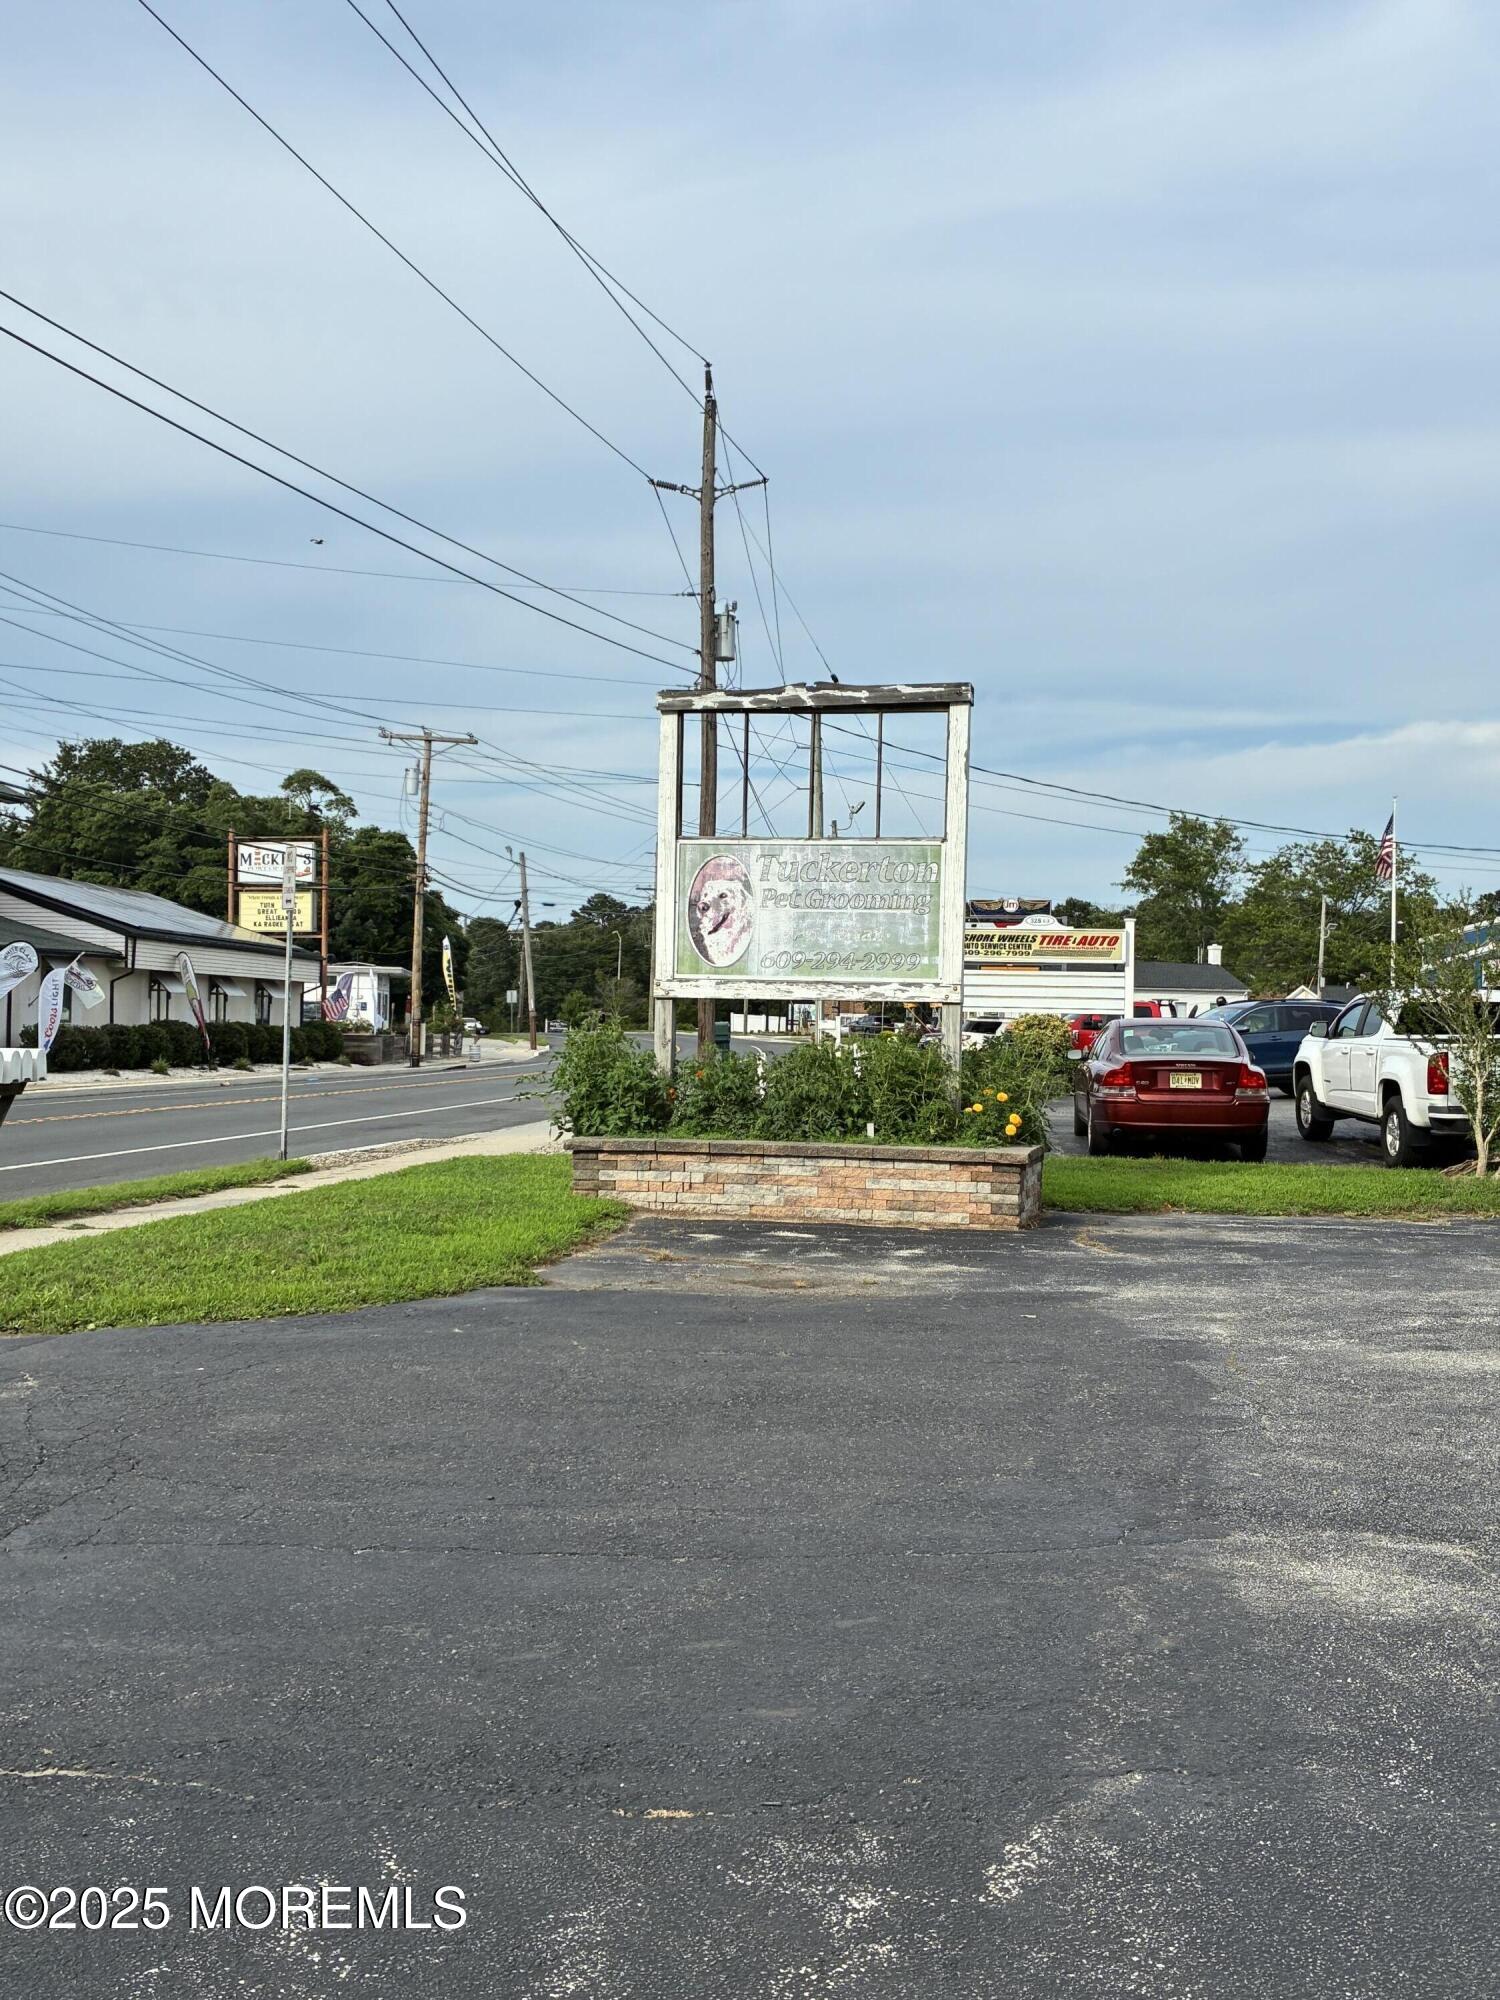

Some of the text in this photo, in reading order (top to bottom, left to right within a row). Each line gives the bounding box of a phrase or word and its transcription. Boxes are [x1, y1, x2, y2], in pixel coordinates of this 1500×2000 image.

[756, 852, 939, 884] Tuckerton
[760, 887, 932, 915] Pet Grooming
[964, 933, 1038, 943] SHORE WHEELS
[1039, 935, 1073, 946] TIRE
[1076, 935, 1120, 946] AUTO
[760, 950, 920, 972] 609-294-2999
